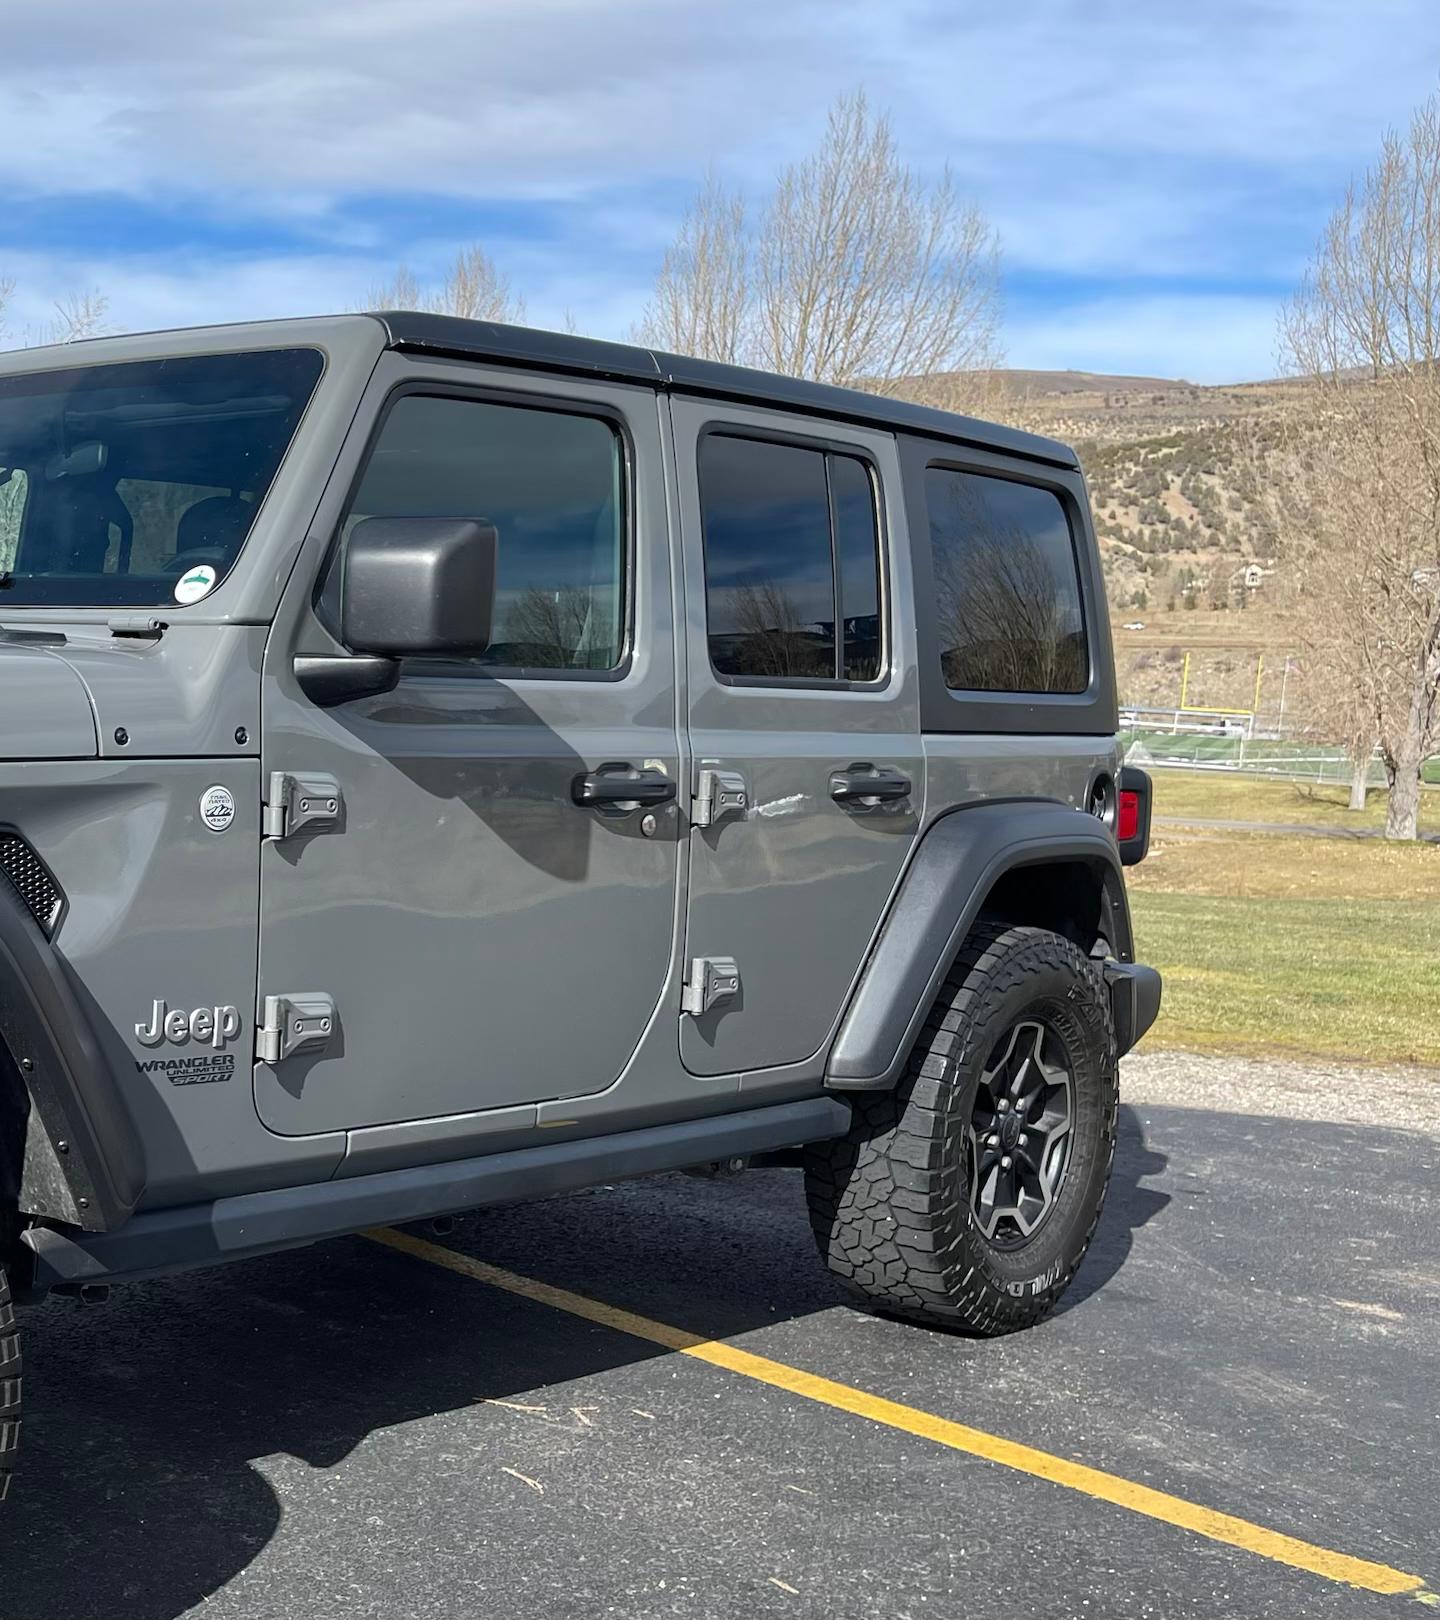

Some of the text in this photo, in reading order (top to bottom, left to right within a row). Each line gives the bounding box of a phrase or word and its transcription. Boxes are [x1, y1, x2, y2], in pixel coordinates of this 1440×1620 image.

[135, 999, 239, 1048] Jeep
[135, 1054, 235, 1073] WRANGLER
[166, 1064, 235, 1076] UNLIMITED
[173, 1073, 232, 1085] SPORT
